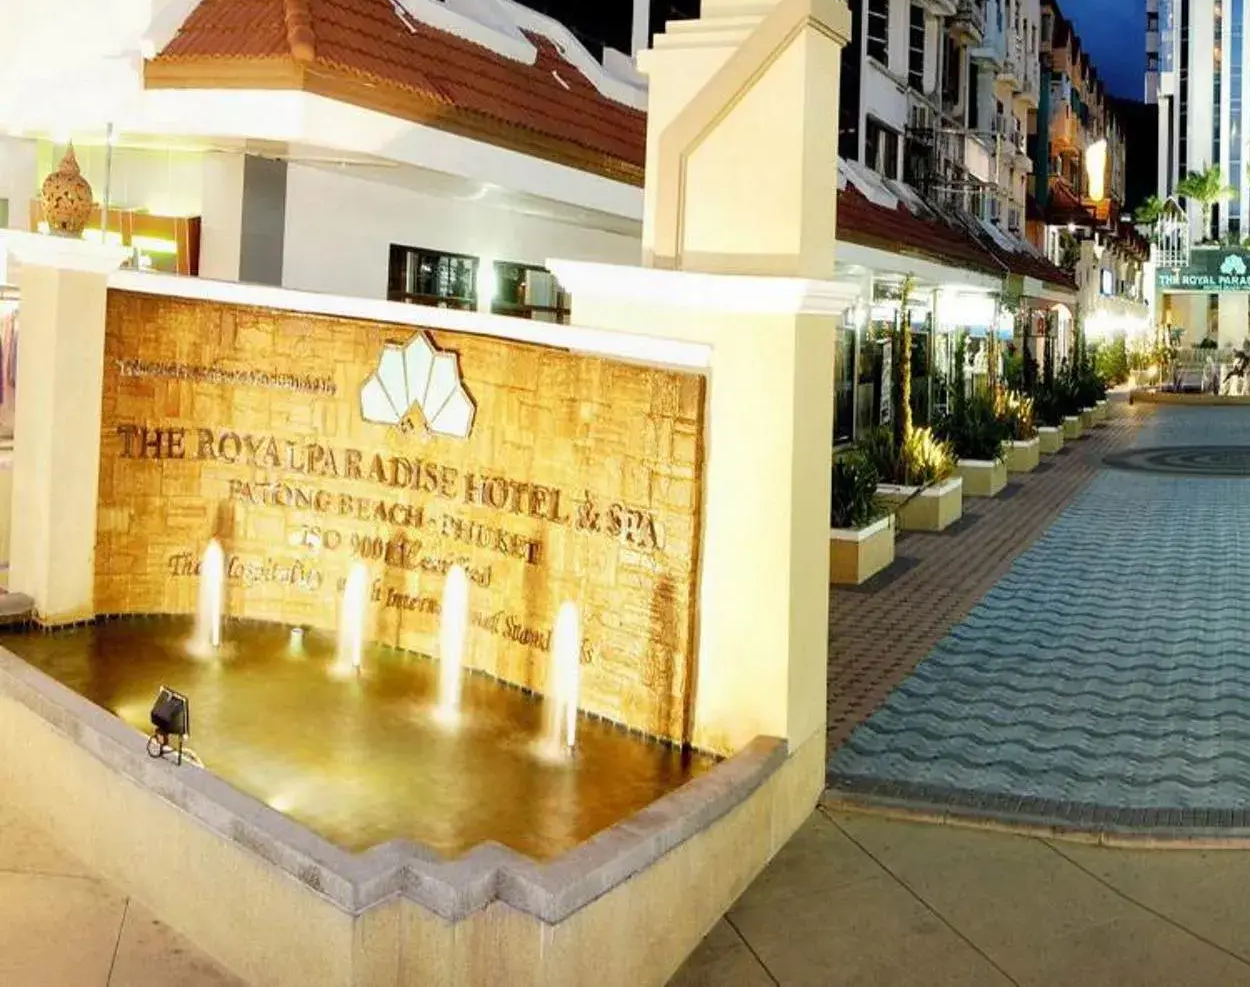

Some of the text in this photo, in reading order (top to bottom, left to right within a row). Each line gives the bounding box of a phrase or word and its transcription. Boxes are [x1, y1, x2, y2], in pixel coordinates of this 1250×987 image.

[1159, 275, 1180, 285] THE
[1182, 275, 1215, 285] ROYAL
[117, 424, 667, 549] THE ROYAL PARADISE HOTEL & SPA
[228, 479, 332, 513] PATONG
[338, 495, 424, 529] BEACH
[440, 513, 542, 564] PHUKET
[168, 550, 204, 578] Tha
